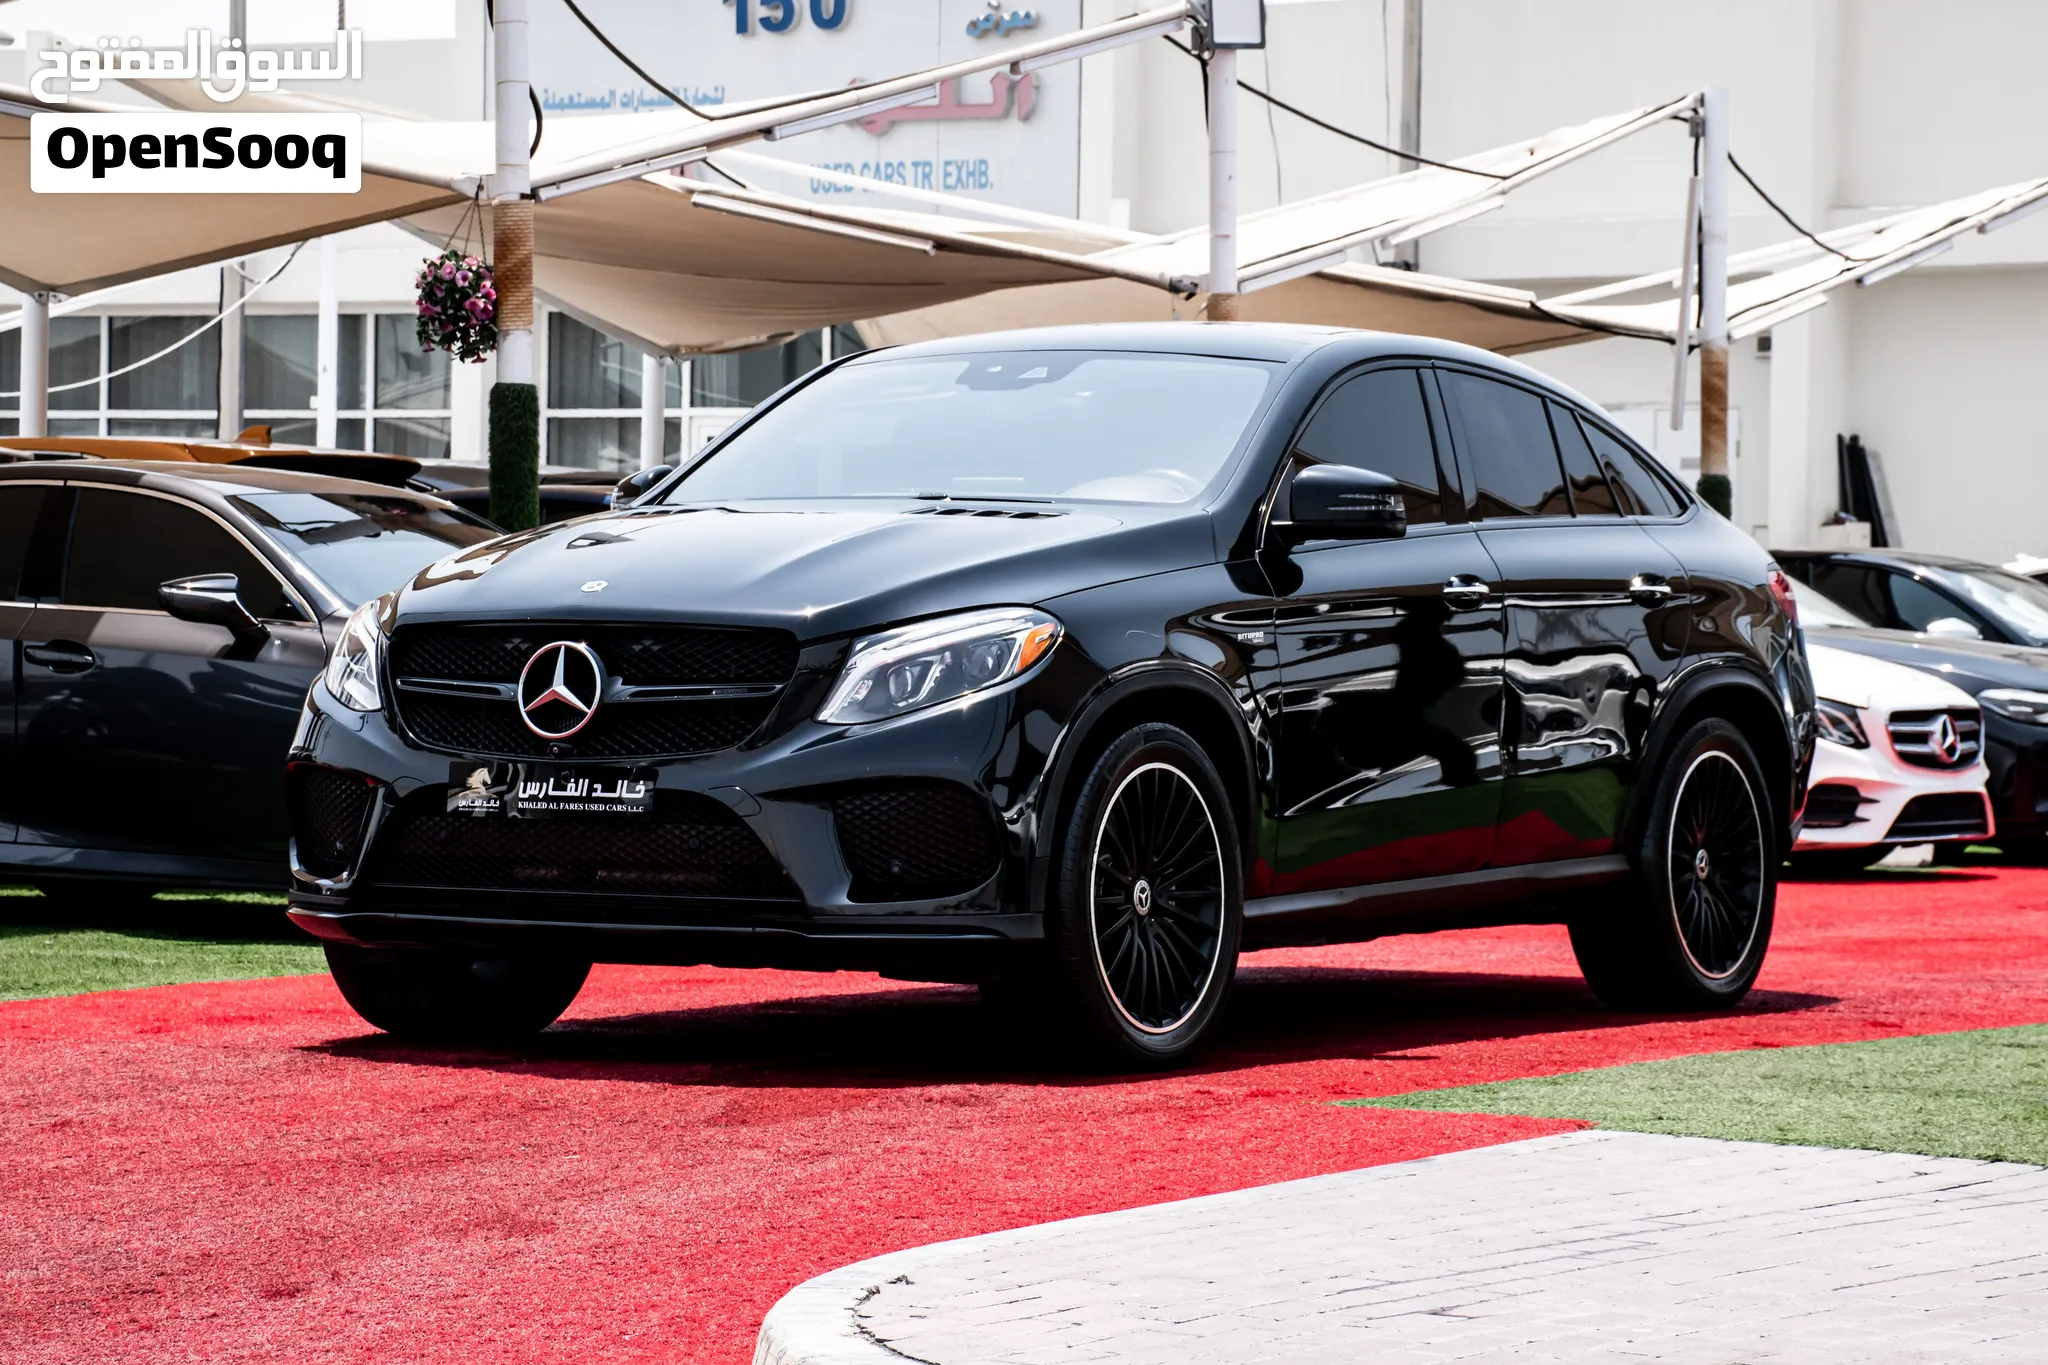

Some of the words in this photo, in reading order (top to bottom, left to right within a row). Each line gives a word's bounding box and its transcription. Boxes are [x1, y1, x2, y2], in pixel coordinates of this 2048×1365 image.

[722, 0, 847, 36] 150
[966, 0, 1036, 38] معرض
[542, 88, 617, 112] المستعملة
[810, 162, 855, 195] USED
[860, 161, 907, 193] CARS
[518, 778, 589, 799] الفارس
[592, 779, 646, 799] خالد
[518, 801, 547, 810] KHALED
[548, 802, 559, 810] AL
[560, 802, 584, 811] FARES
[585, 803, 605, 811] USED
[606, 804, 627, 812] CARS
